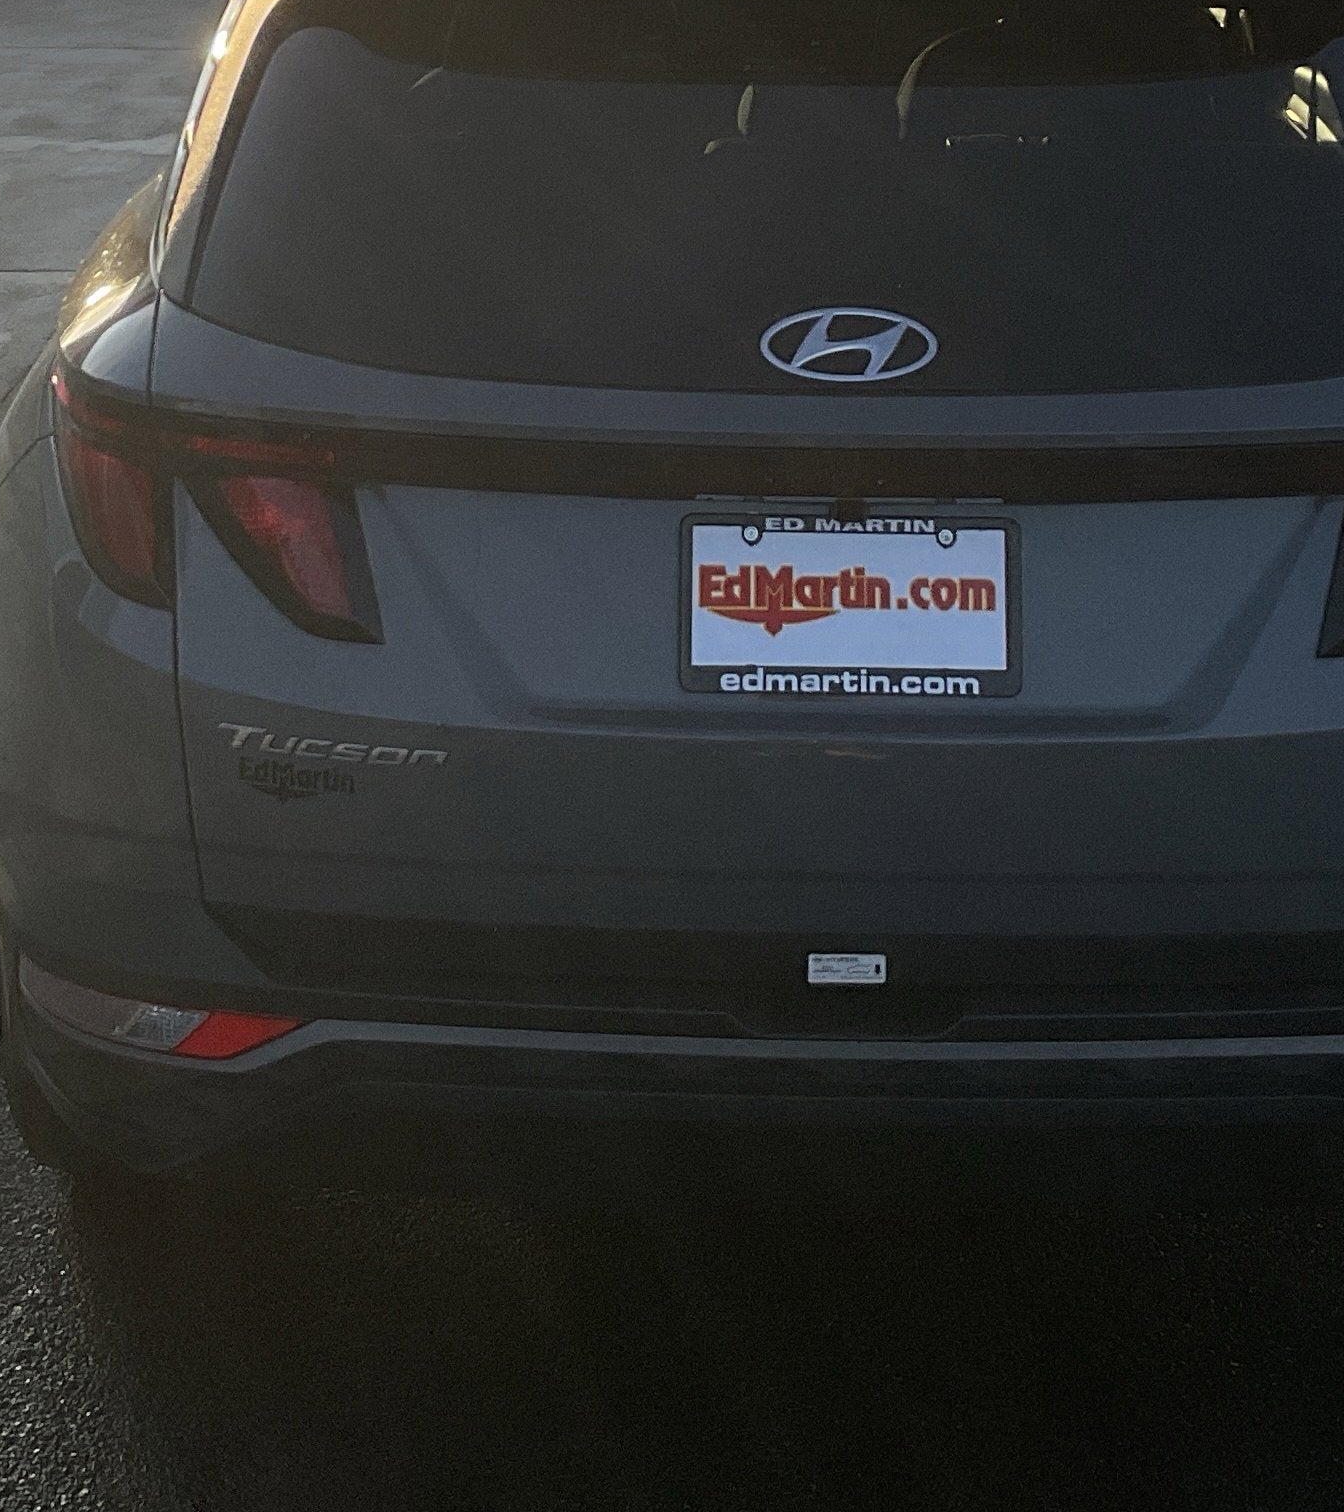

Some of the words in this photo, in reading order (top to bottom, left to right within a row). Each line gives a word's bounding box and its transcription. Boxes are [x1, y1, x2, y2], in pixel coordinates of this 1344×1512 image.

[764, 517, 806, 532] ED
[815, 518, 936, 534] MARTIN
[698, 564, 997, 613] EdMartin.com
[719, 667, 981, 696] edmartin.com
